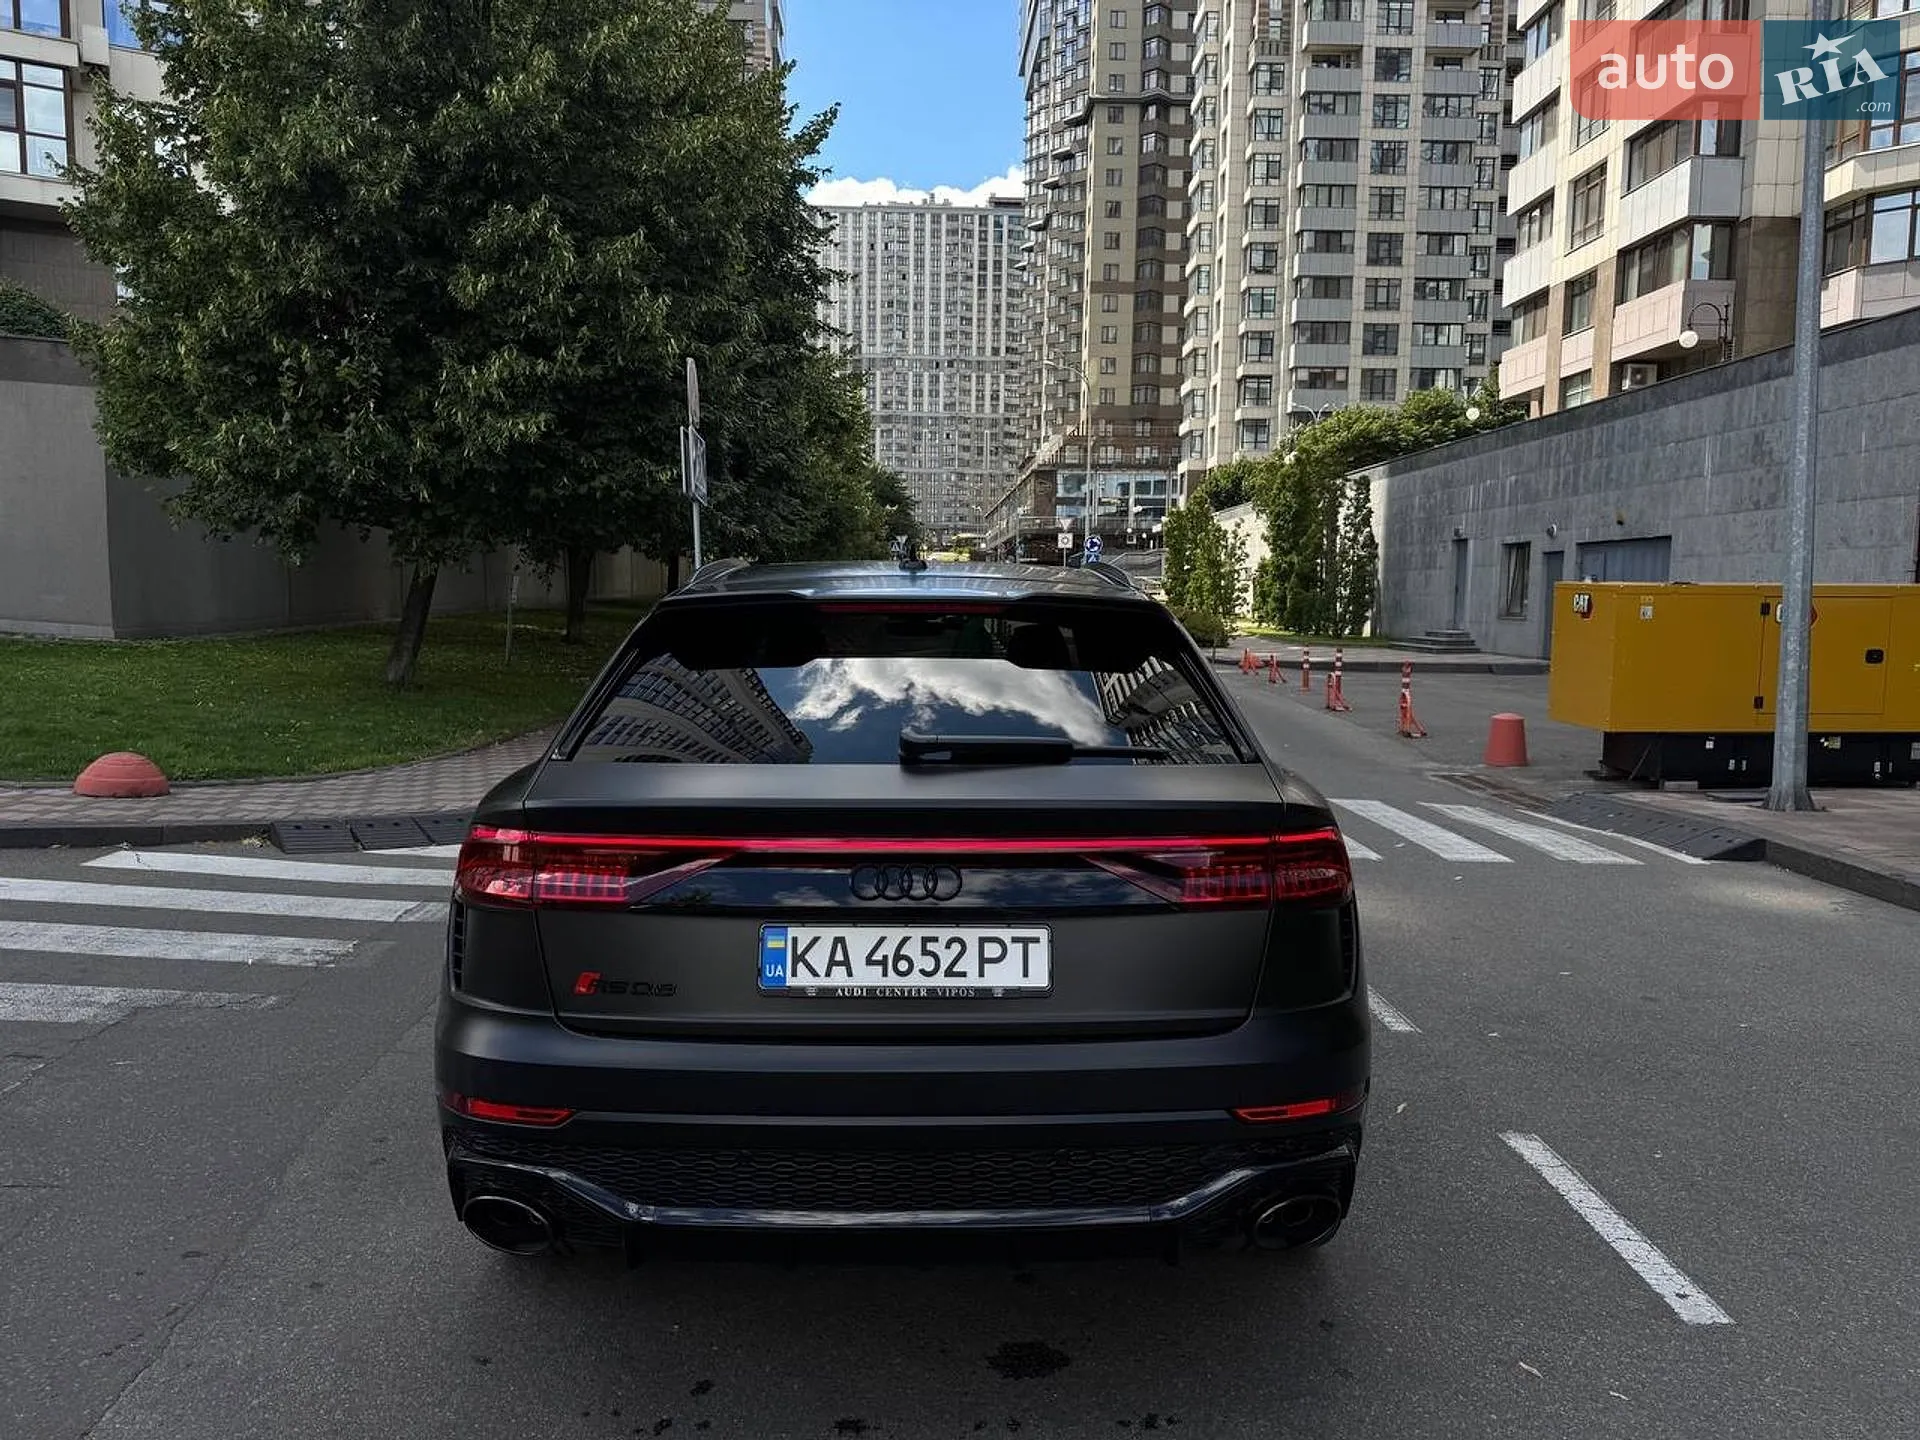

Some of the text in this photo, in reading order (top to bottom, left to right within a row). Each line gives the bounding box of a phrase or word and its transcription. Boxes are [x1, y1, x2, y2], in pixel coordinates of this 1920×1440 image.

[790, 936, 1041, 978] KA 4652 PT
[765, 965, 784, 977] UA
[835, 987, 867, 997] AUDI
[876, 987, 927, 997] CENTER
